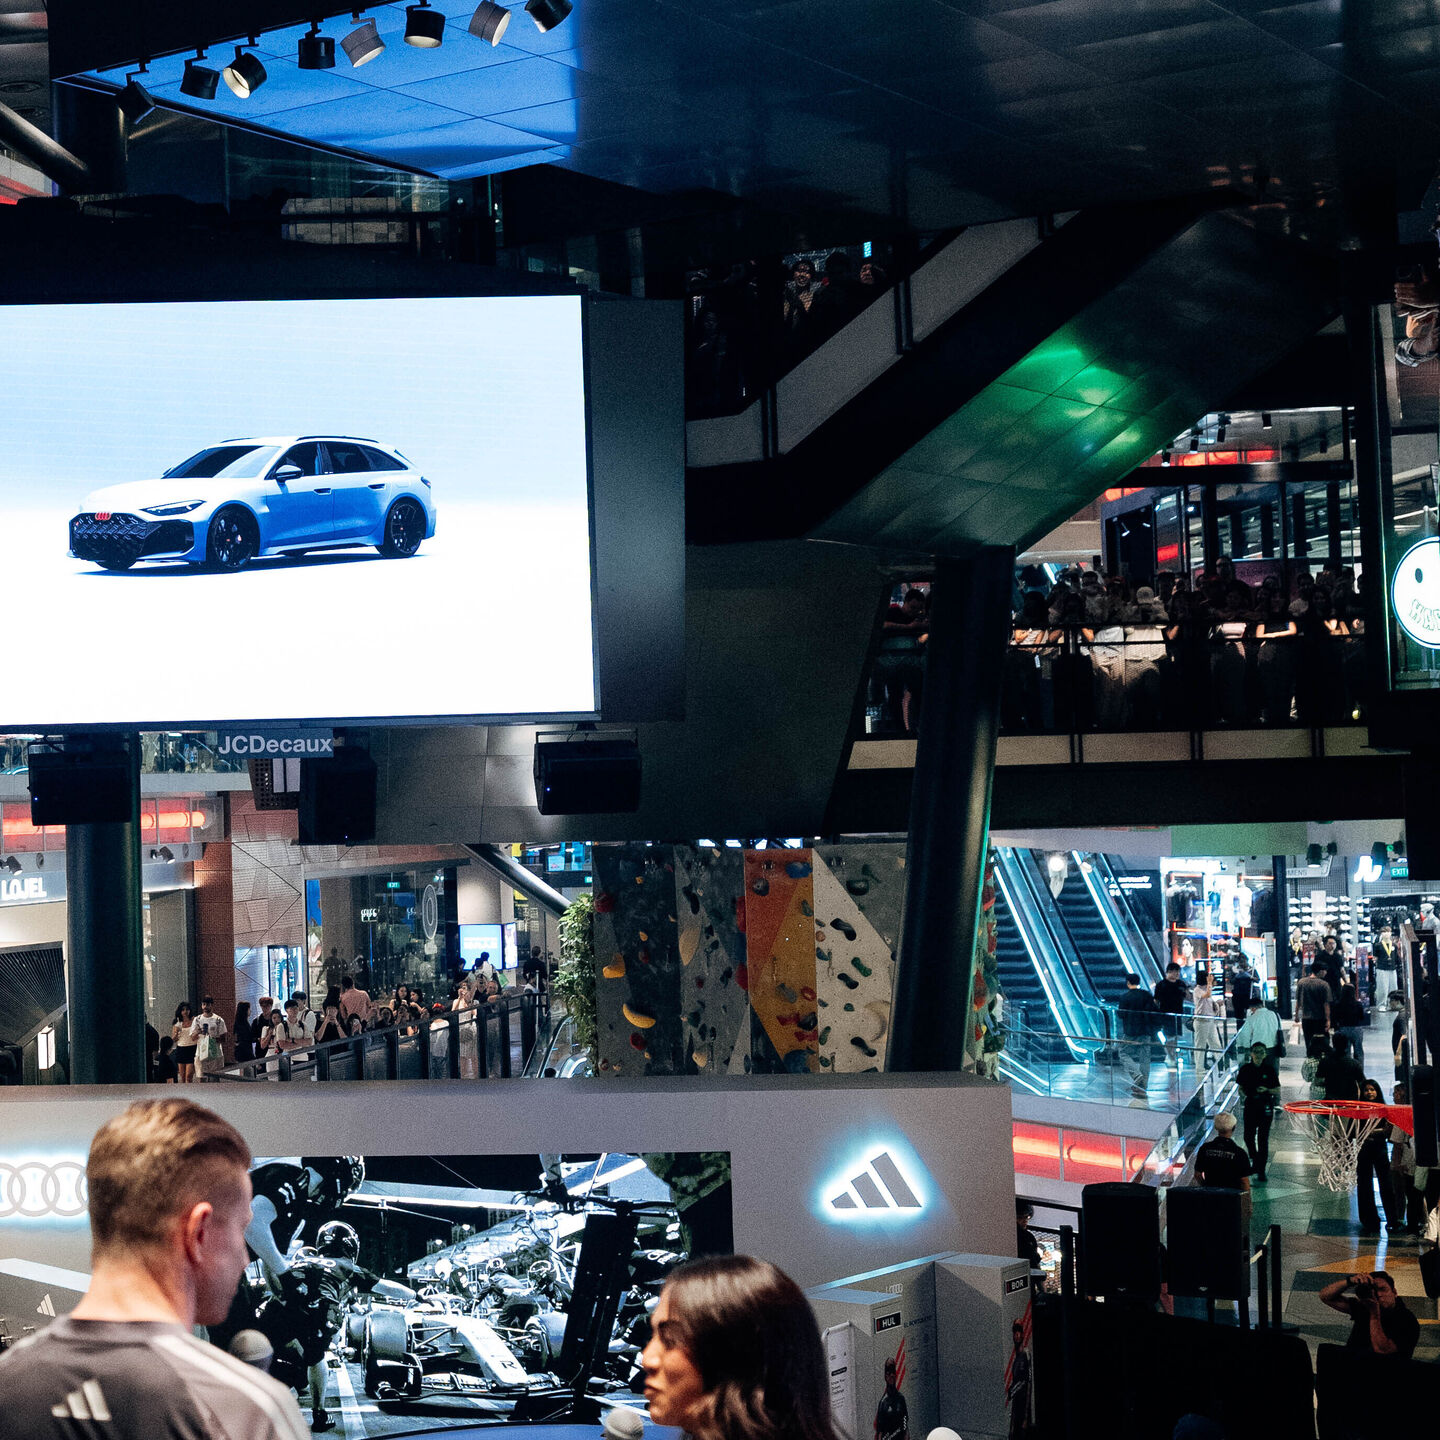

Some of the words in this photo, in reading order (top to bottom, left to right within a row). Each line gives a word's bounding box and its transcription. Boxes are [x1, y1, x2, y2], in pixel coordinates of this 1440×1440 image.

[218, 735, 333, 754] JCDecaux
[1391, 868, 1406, 876] EXIT
[0, 877, 47, 900] LOJEL
[1011, 1279, 1024, 1290] BOR
[882, 1317, 896, 1328] HUL
